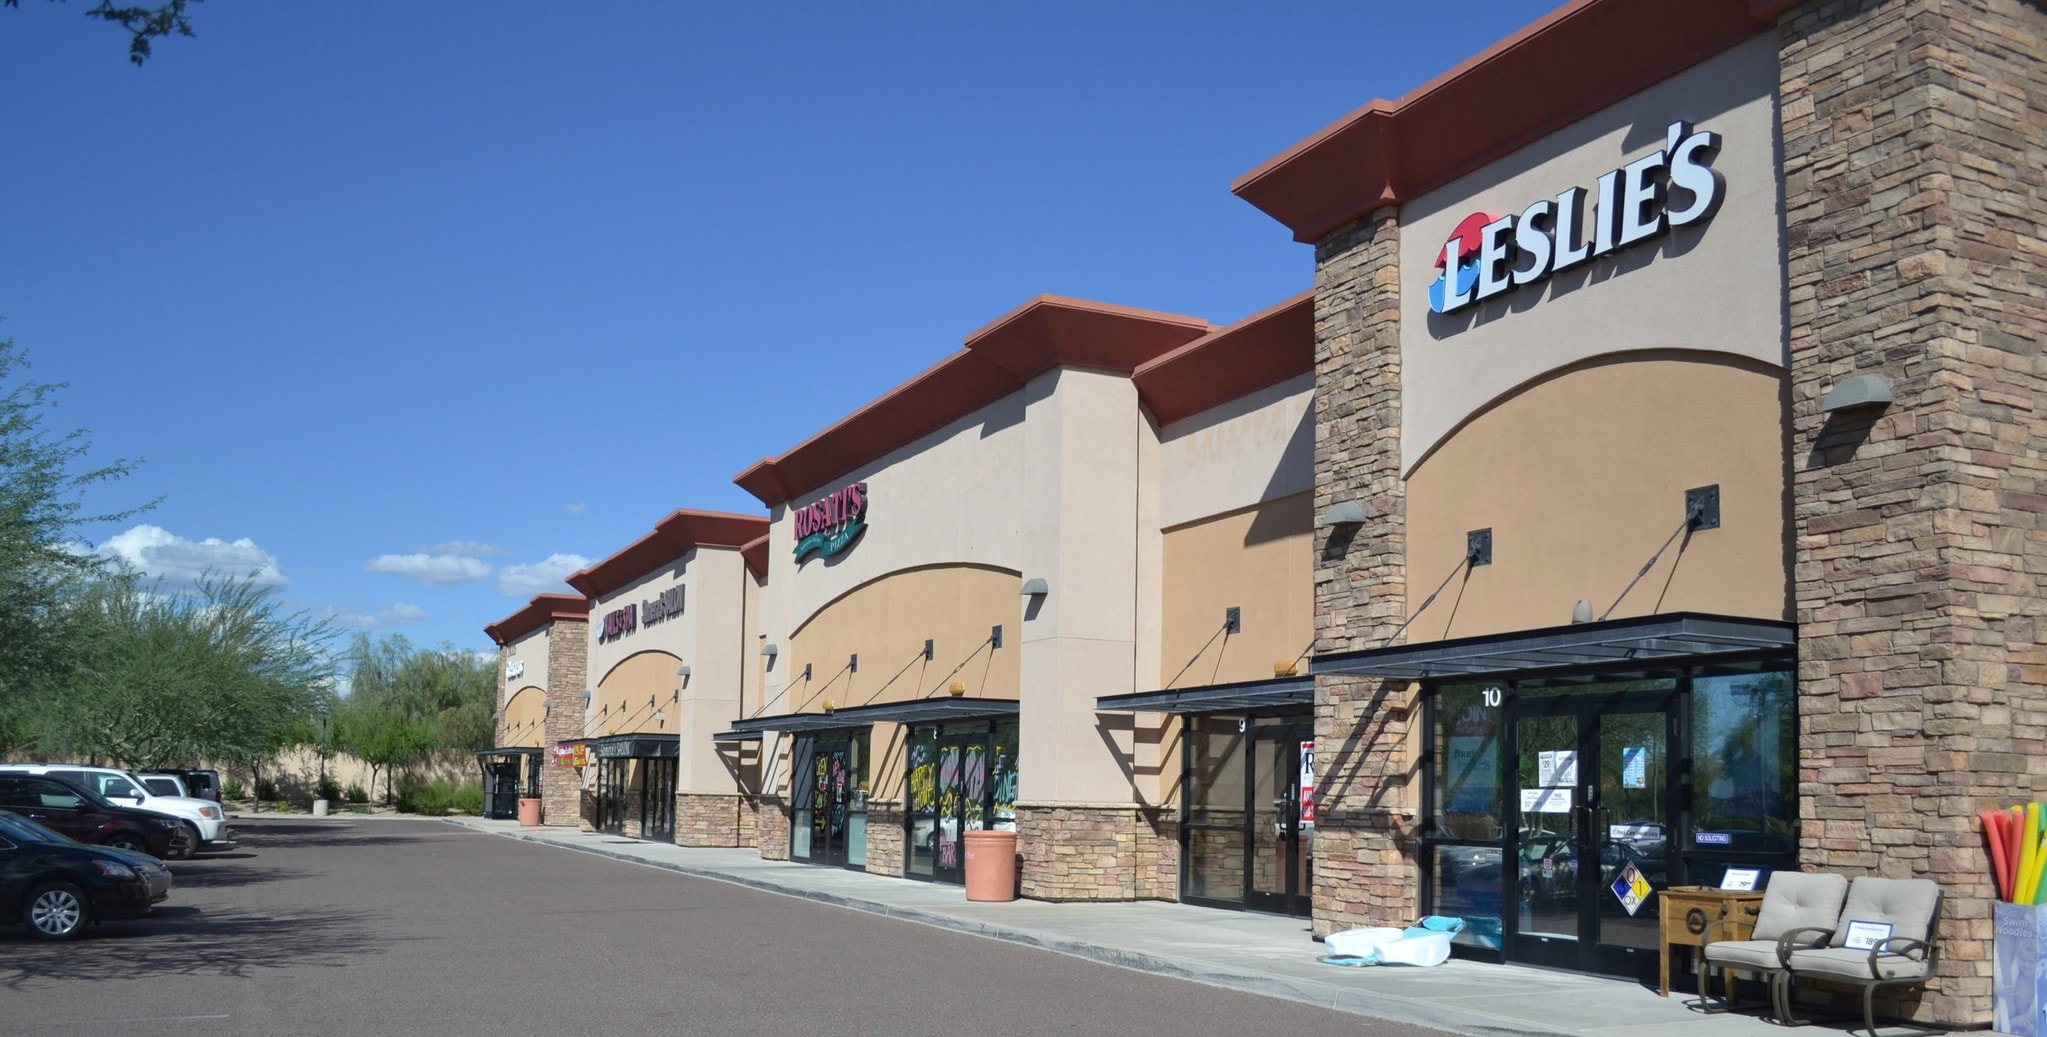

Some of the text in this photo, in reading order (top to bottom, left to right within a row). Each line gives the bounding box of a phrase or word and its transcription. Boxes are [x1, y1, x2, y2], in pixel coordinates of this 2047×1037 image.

[1442, 119, 1724, 313] LESLIE'S
[794, 482, 864, 541] ROSATI'S
[829, 532, 849, 552] PIZZA
[1482, 687, 1502, 707] 10
[1238, 719, 1246, 733] 9
[2002, 916, 2028, 928] Swim
[1995, 926, 2034, 939] Noodles
